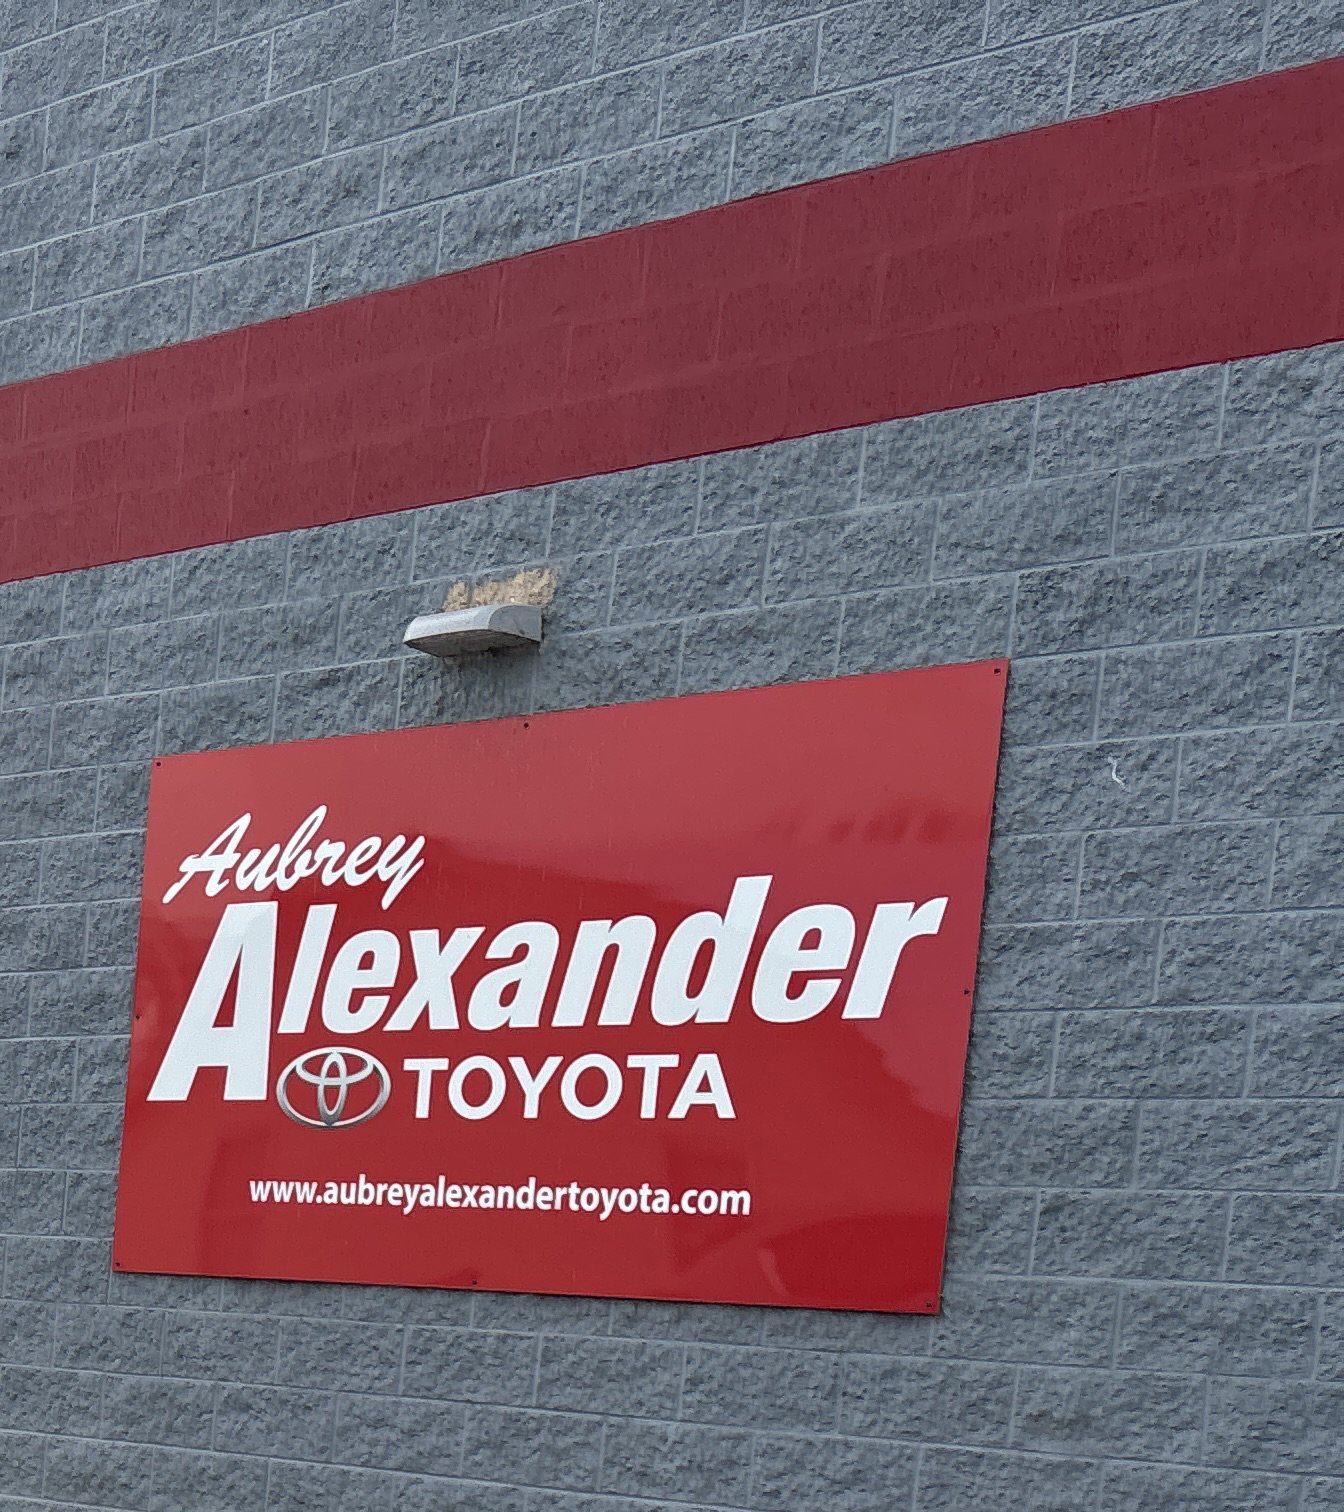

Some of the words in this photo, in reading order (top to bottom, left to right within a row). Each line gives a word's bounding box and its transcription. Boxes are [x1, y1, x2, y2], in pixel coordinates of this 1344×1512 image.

[163, 805, 424, 910] Aubrey
[147, 875, 948, 1101] Alexander
[404, 1054, 736, 1120] TOYOTA
[249, 1174, 751, 1220] www.aubreyalexandertoyota.com
